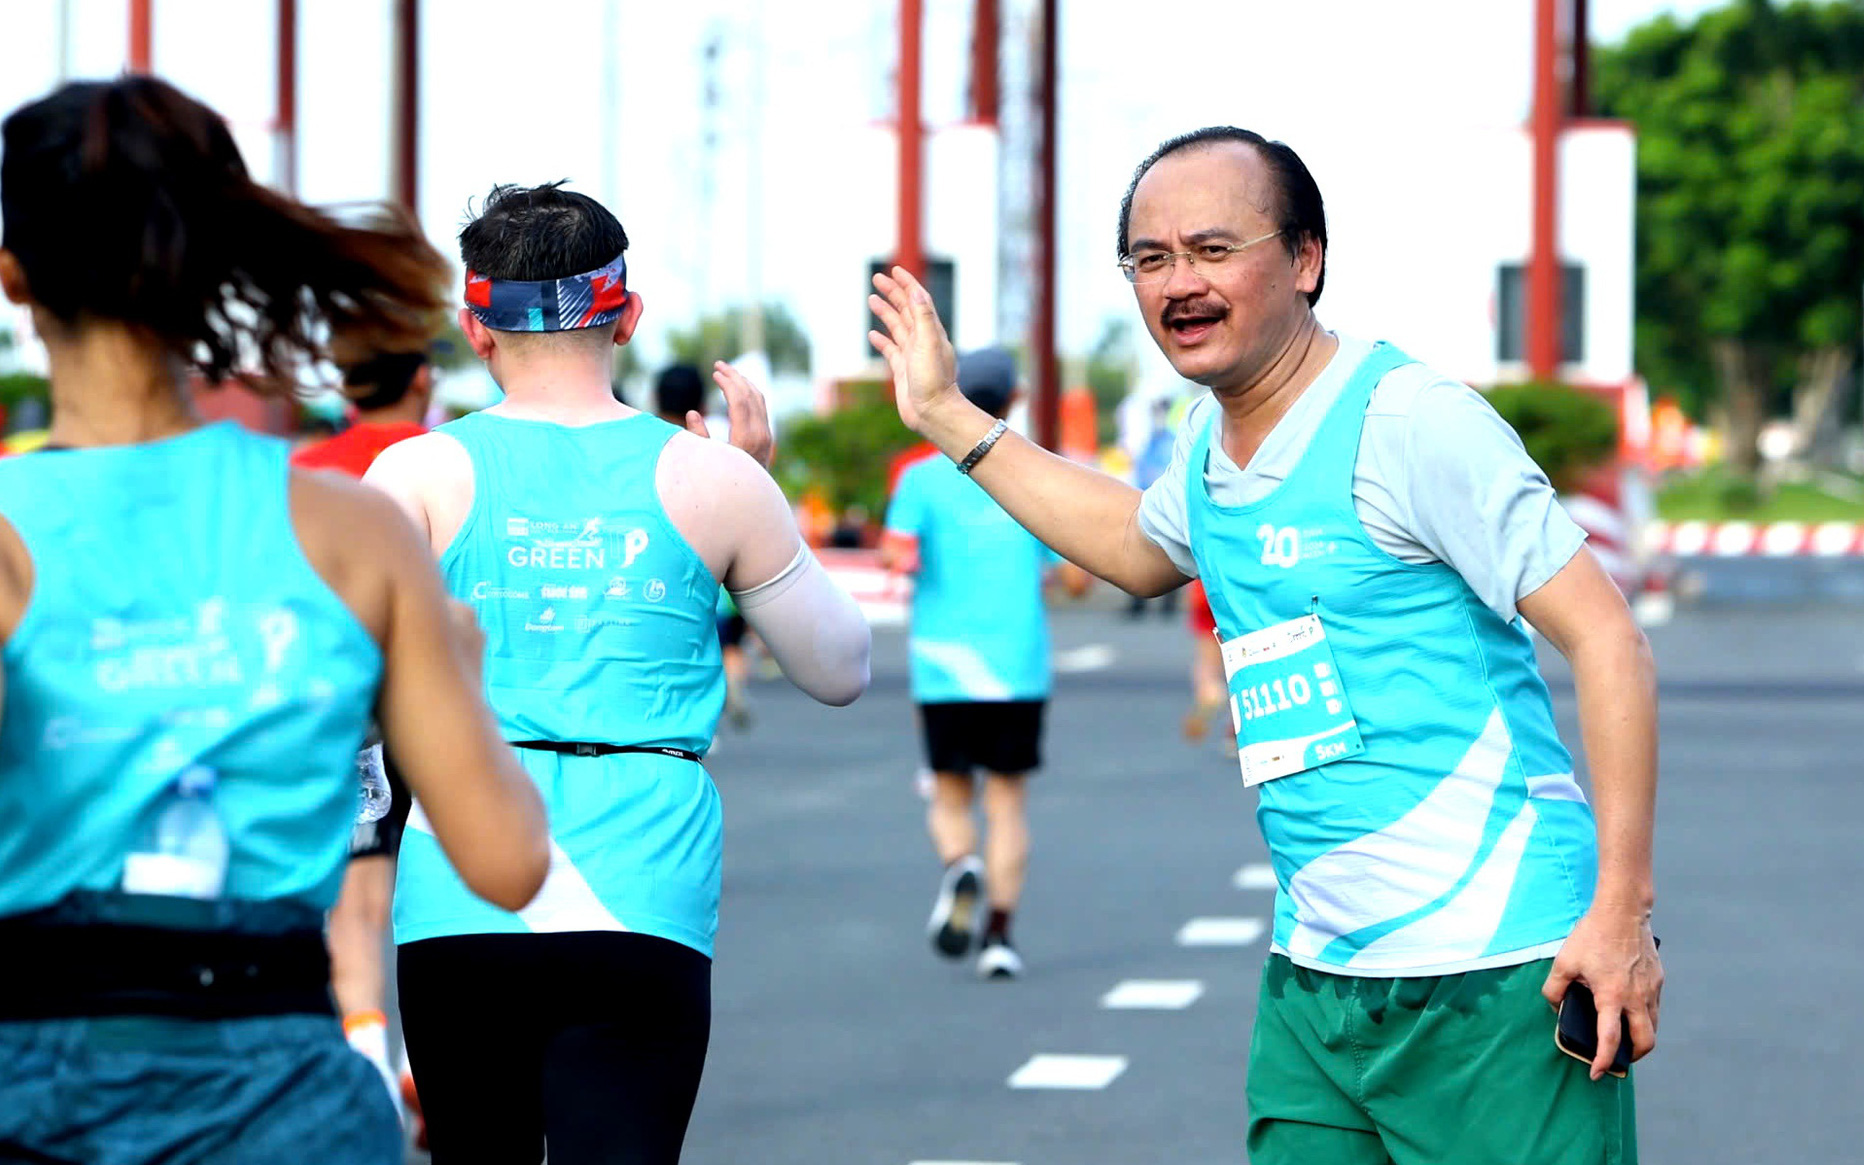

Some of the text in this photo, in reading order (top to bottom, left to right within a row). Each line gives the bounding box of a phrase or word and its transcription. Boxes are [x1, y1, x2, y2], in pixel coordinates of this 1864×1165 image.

[507, 547, 605, 569] GREEN
[1256, 523, 1299, 568] 20
[1241, 673, 1311, 721] 51110
[1314, 741, 1347, 760] 5KM
